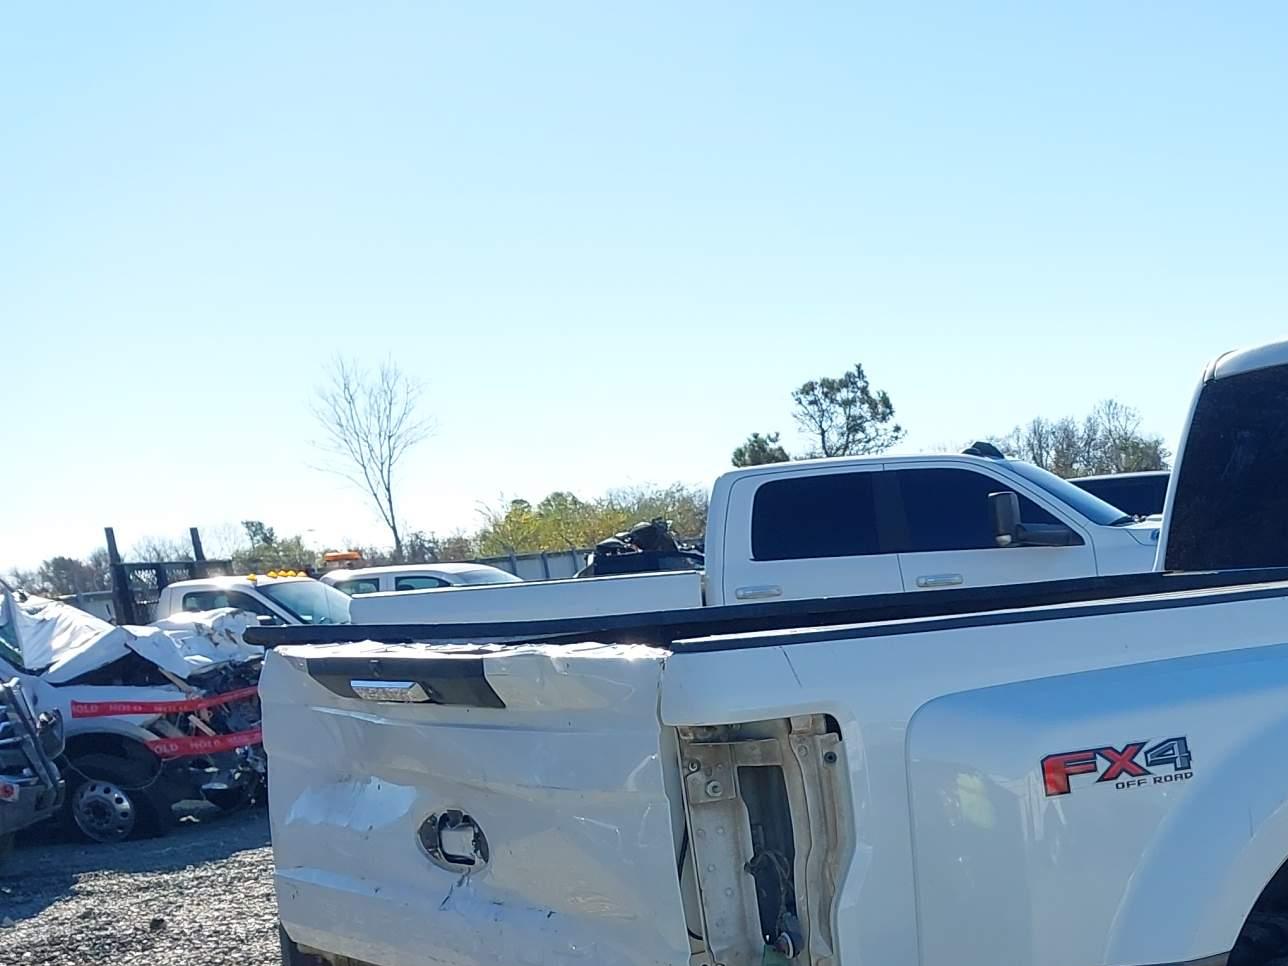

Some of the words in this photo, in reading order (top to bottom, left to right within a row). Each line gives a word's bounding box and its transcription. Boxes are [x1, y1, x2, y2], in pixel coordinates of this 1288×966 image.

[1041, 736, 1192, 797] FX4
[1115, 778, 1148, 790] OFF
[1152, 771, 1194, 785] ROAD
